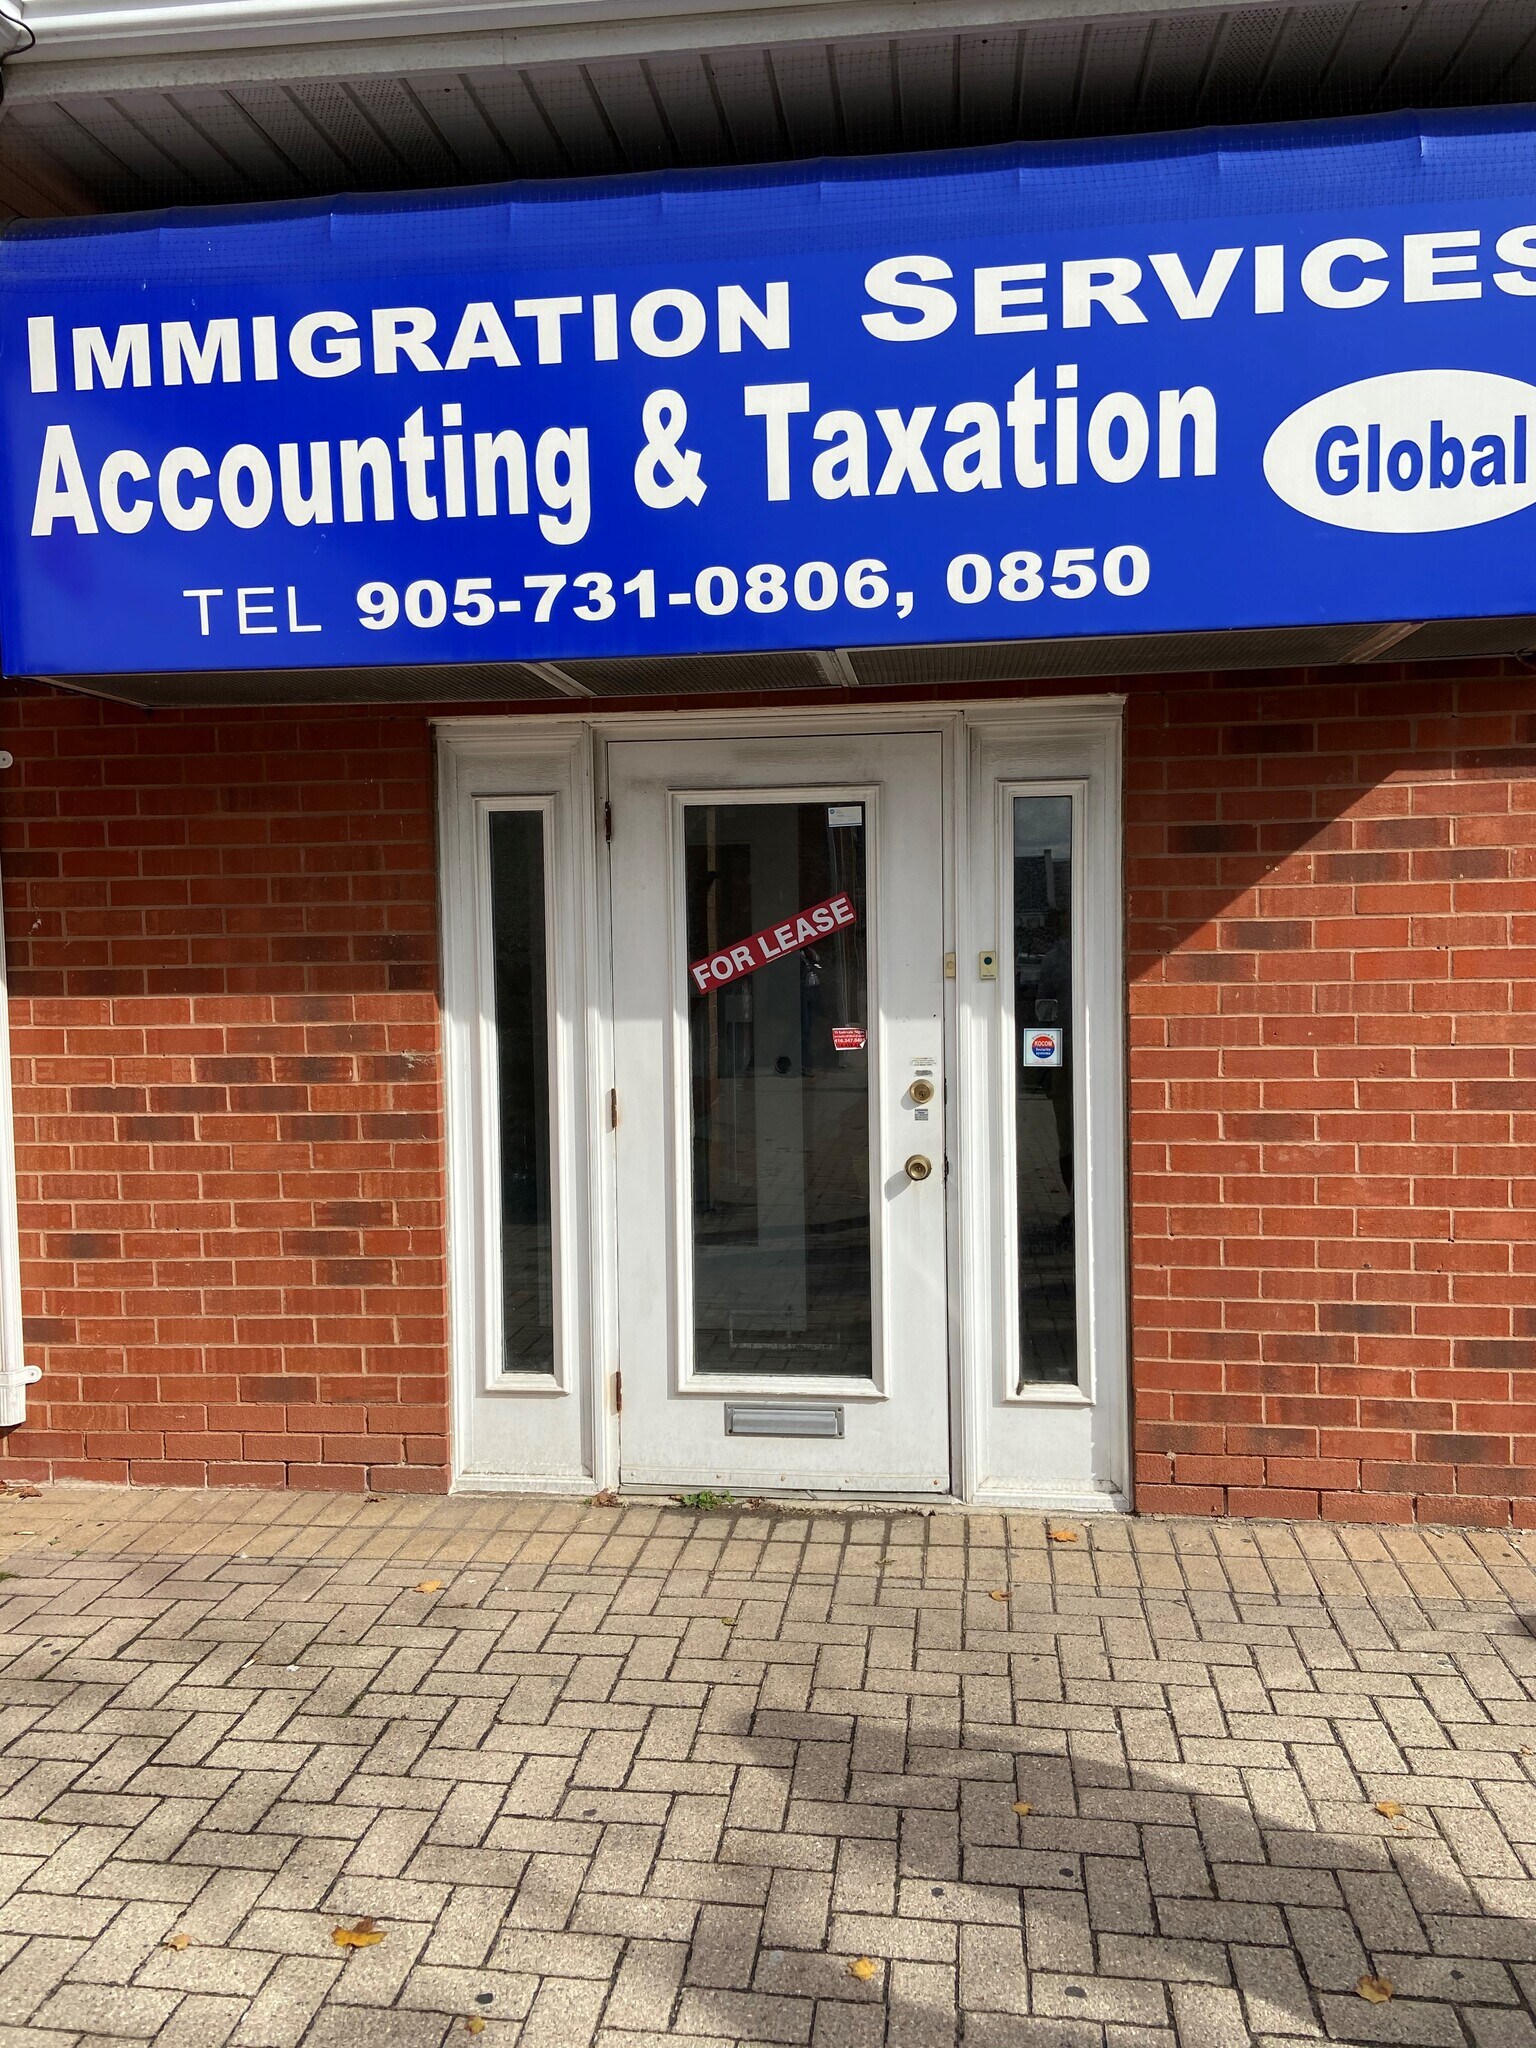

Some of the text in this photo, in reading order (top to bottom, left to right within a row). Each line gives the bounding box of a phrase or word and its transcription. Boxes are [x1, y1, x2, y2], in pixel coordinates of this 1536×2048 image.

[27, 224, 1536, 394] IMMIGRATION SERVICES
[30, 363, 1217, 546] Accounting & Taxation
[1314, 414, 1527, 497] Global
[182, 544, 1150, 636] TEL 905-731-0806, 0850
[692, 897, 855, 990] FOR LEASE
